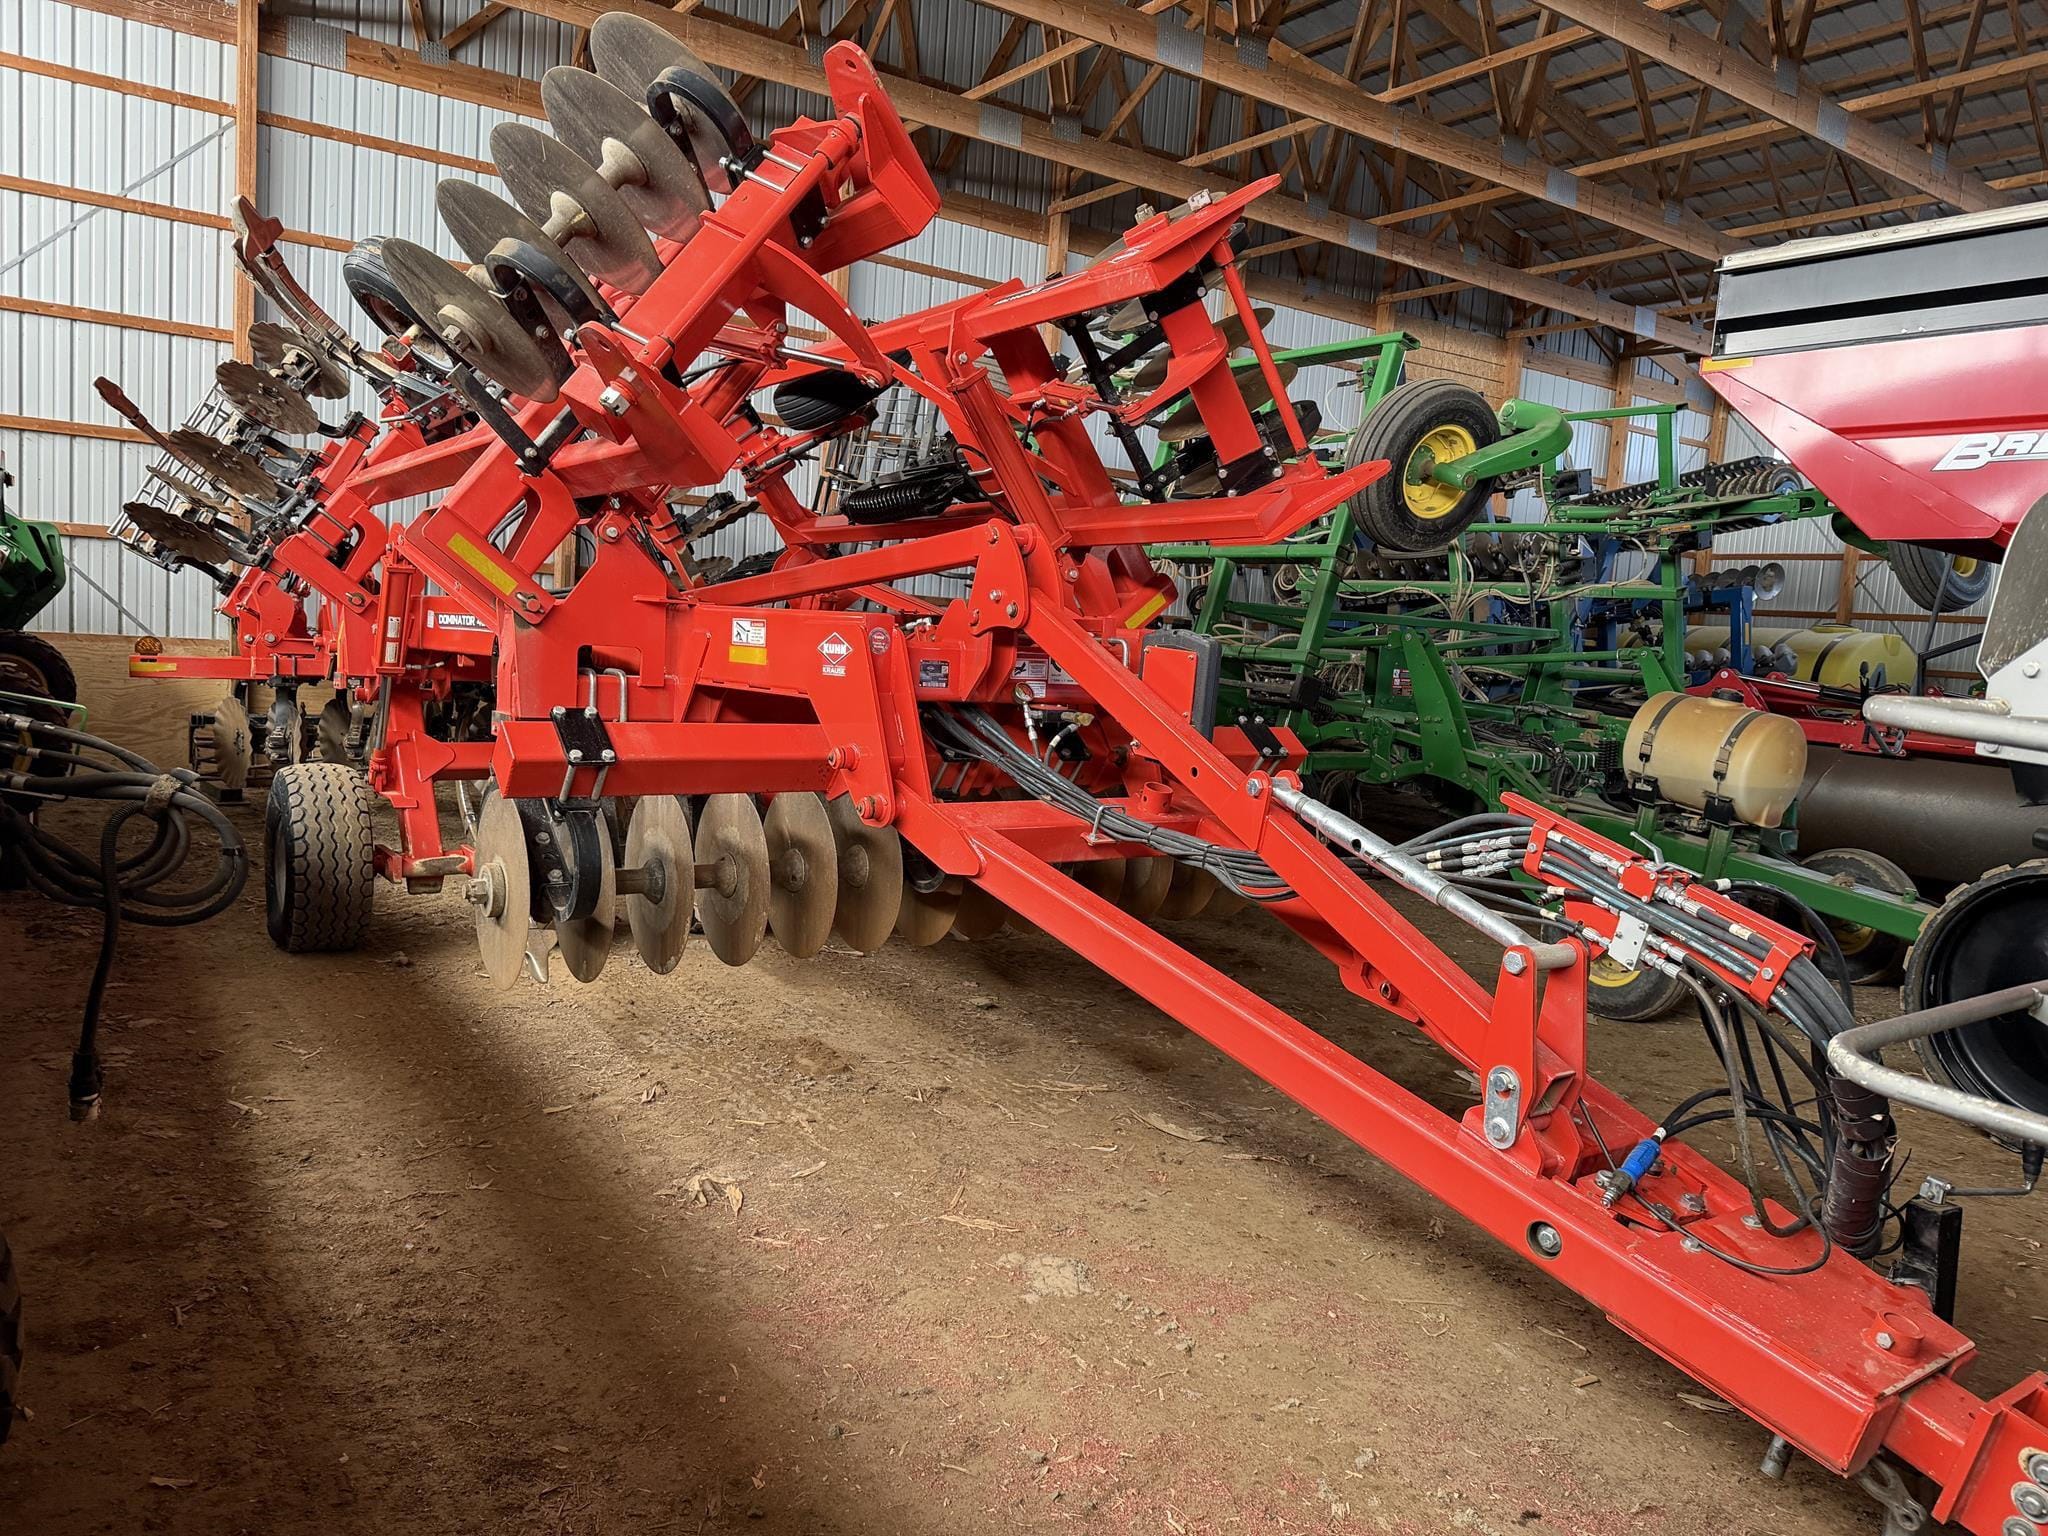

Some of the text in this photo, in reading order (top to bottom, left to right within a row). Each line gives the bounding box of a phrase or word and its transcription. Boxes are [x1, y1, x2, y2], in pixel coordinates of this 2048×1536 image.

[438, 614, 475, 626] DOMINATOR
[823, 643, 847, 655] KUHN
[822, 666, 846, 675] KRAUSE
